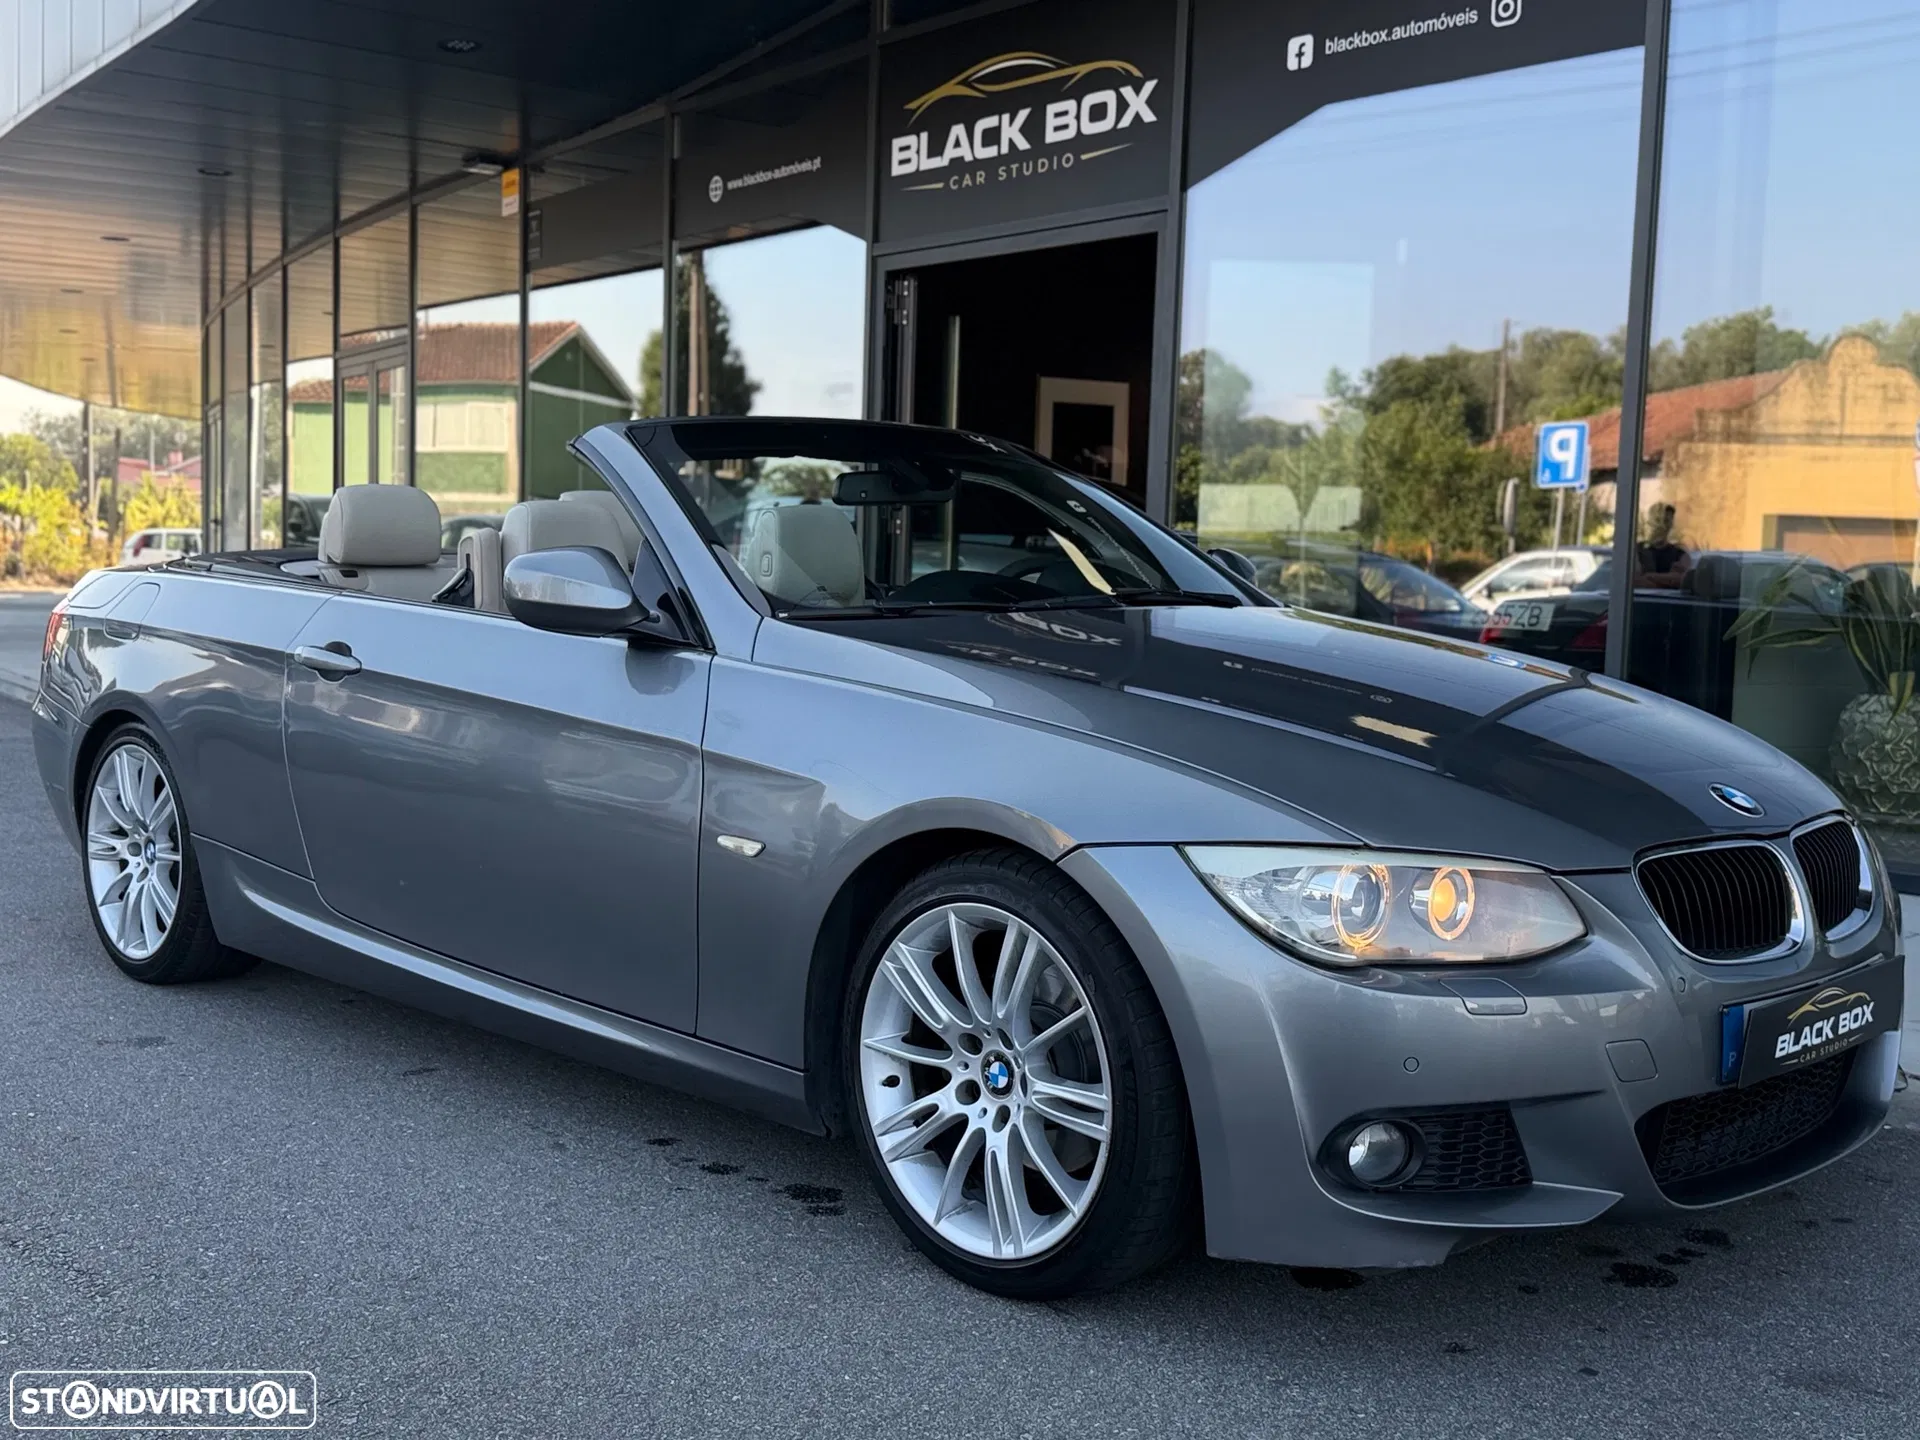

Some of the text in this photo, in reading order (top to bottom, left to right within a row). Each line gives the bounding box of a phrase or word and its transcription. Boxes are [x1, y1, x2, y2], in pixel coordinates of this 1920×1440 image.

[1325, 8, 1479, 55] blackbox.automóveis
[891, 79, 1159, 177] BLACK BOX
[949, 153, 1074, 190] CAR STUDIO
[1775, 1001, 1875, 1059] BLACK BOX
[1728, 1051, 1737, 1068] P
[1800, 1039, 1848, 1064] CAR STUDIO
